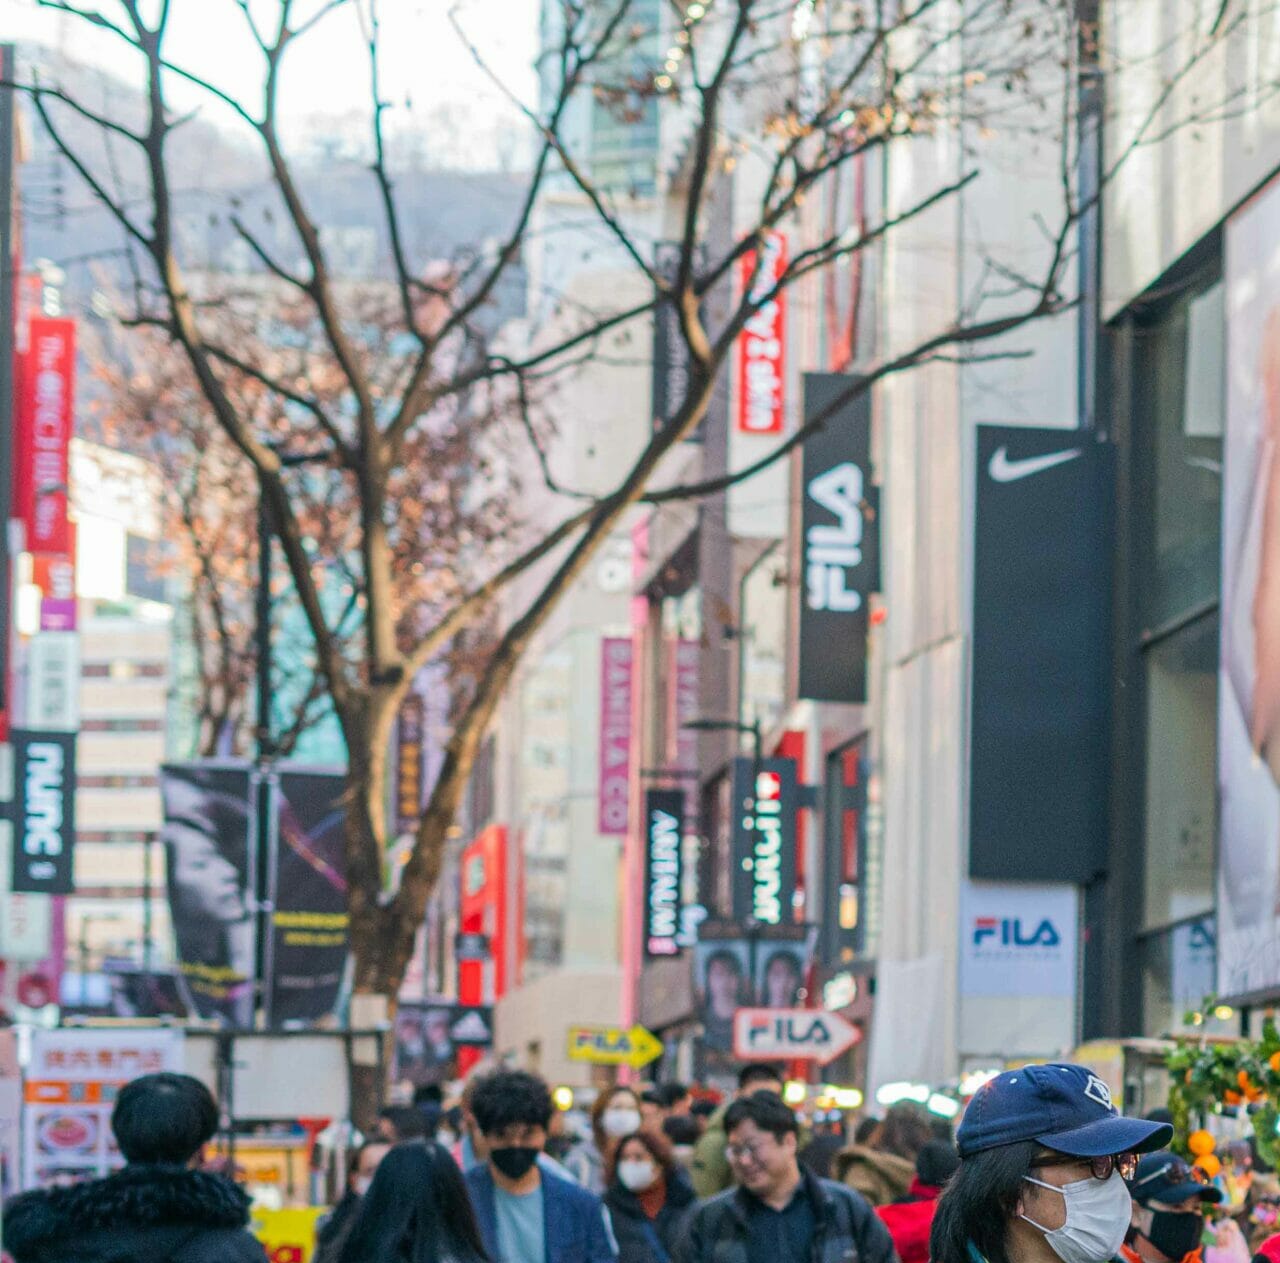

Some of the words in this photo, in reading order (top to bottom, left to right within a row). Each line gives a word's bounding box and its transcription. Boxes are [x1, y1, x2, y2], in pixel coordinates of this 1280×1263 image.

[806, 462, 863, 612] FILA
[973, 917, 1060, 946] FILA
[576, 1030, 631, 1053] FILA
[750, 1016, 830, 1044] FILA
